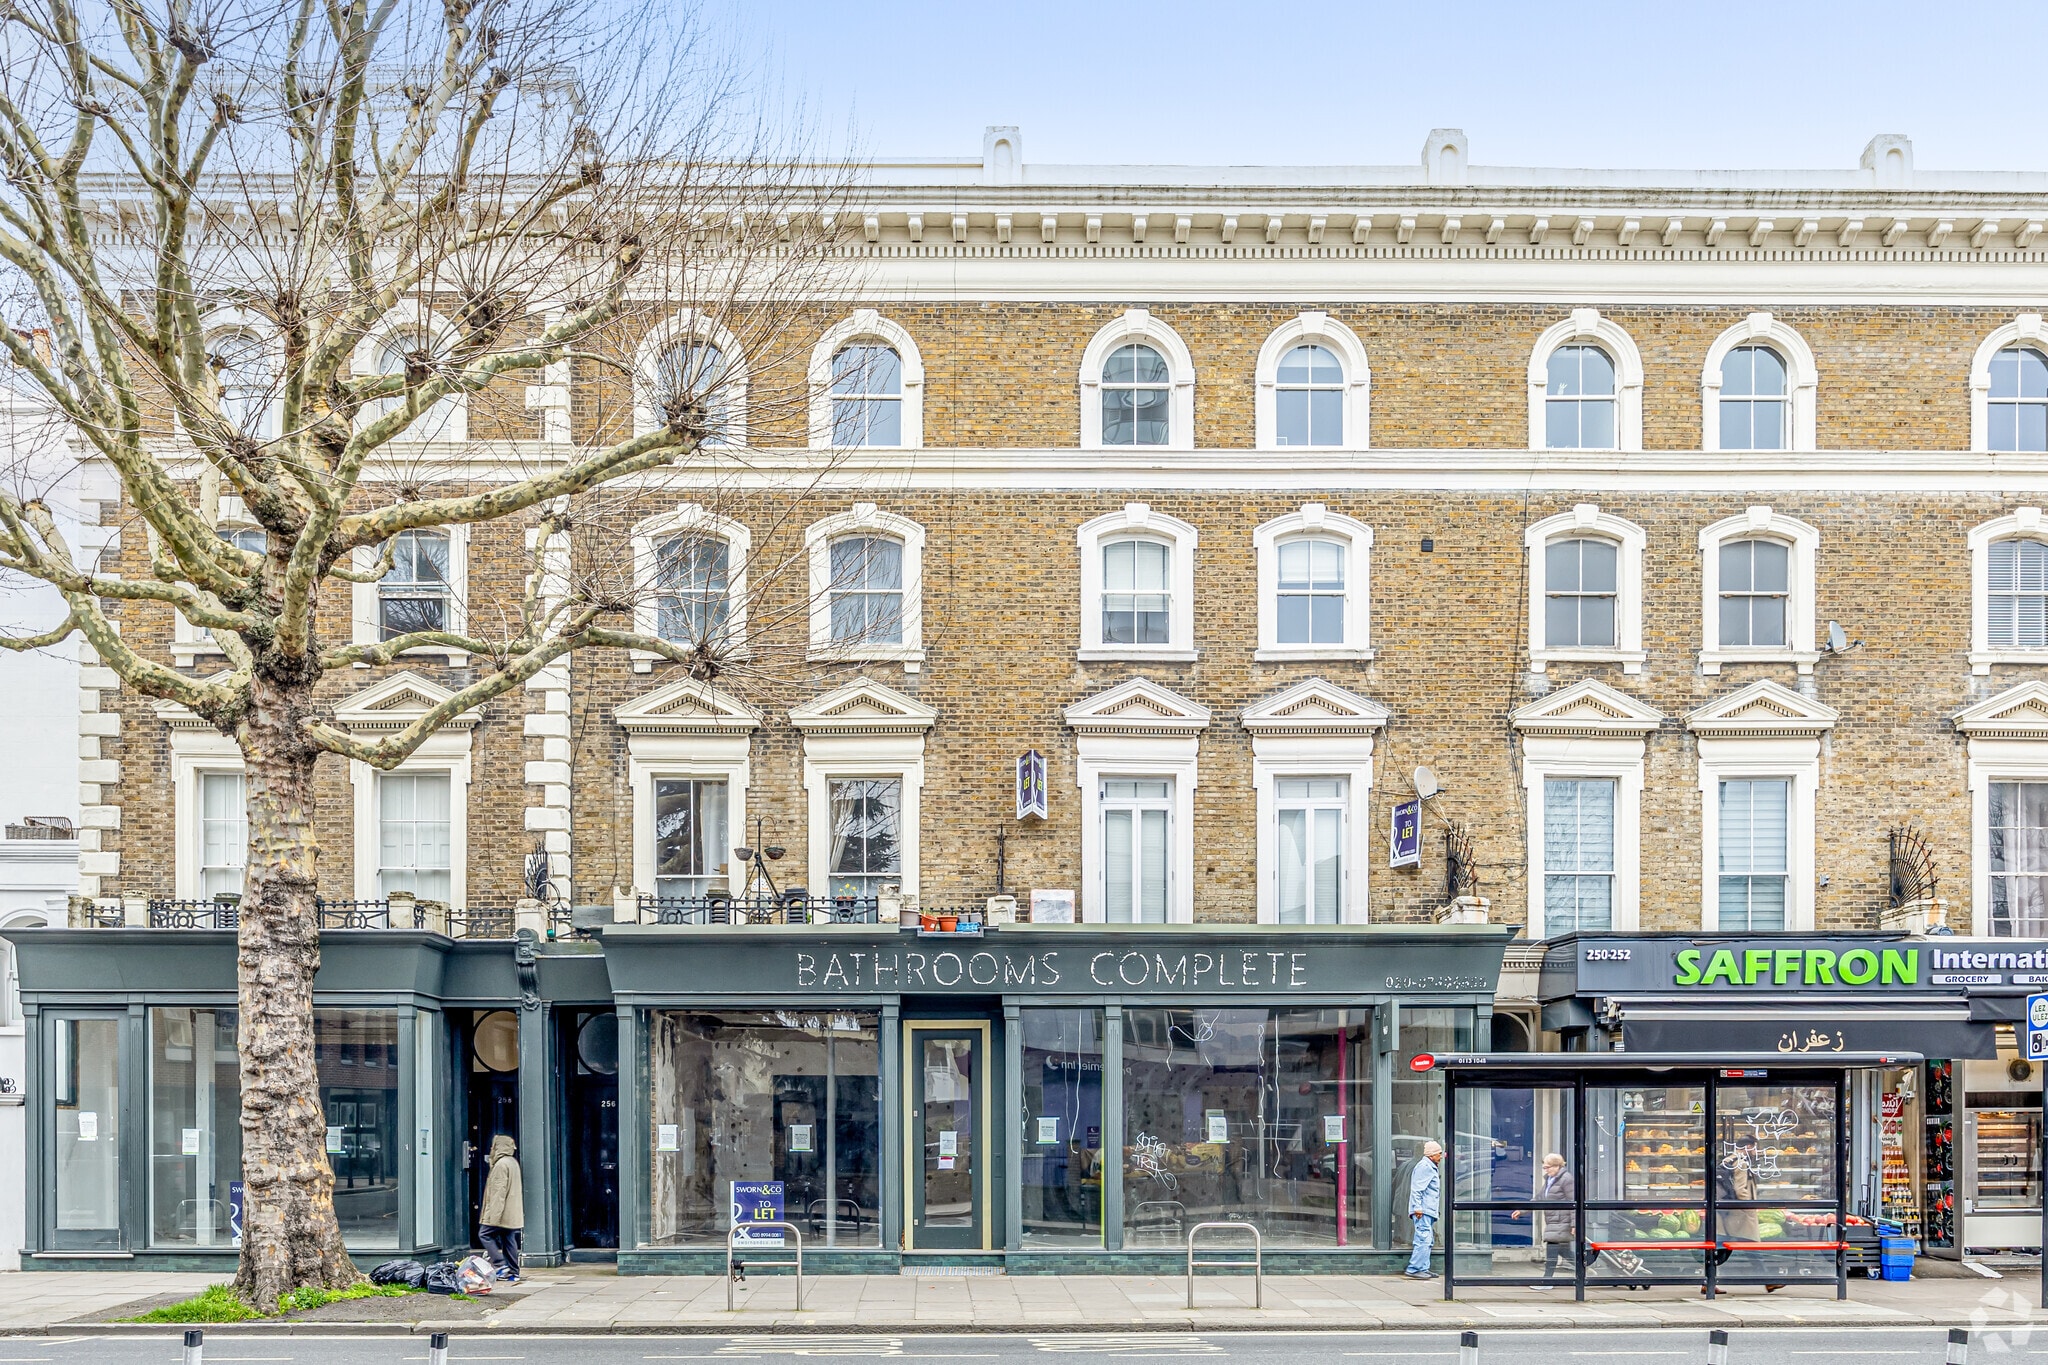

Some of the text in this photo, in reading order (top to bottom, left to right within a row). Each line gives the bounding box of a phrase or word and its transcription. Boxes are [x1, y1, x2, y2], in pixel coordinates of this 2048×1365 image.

[1402, 826, 1413, 839] LET
[1587, 949, 1631, 960] 250-252
[797, 952, 1307, 985] BATHROOMS COMPLETE
[1675, 948, 1919, 985] SAFFRON
[2035, 1004, 2046, 1012] LEZ
[2033, 1013, 2048, 1022] ULEZ
[1777, 1028, 1844, 1053] زعفران
[601, 1100, 616, 1108] 256
[736, 1184, 782, 1195] SWORN&CO
[758, 1200, 771, 1208] TO
[754, 1208, 776, 1220] LET
